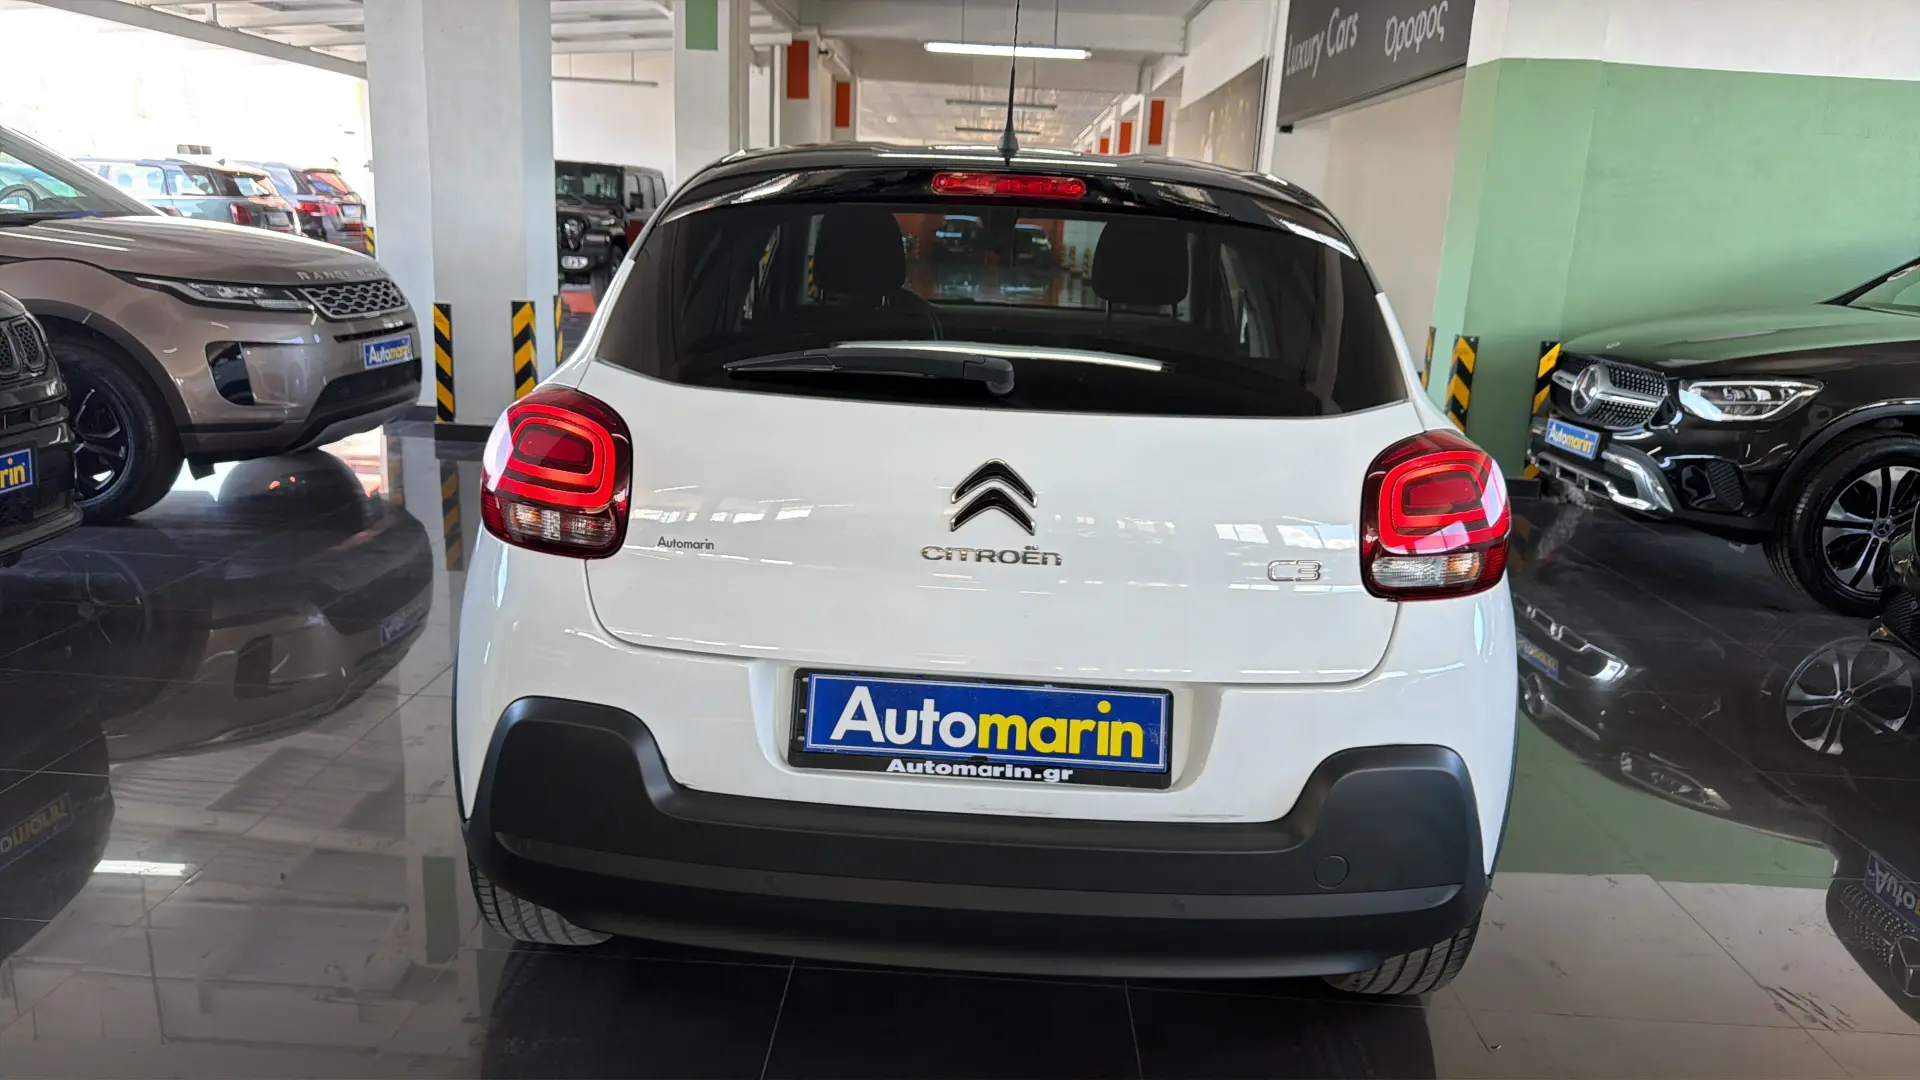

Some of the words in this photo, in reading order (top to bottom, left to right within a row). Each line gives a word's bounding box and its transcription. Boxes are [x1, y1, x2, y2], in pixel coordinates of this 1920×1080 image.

[1286, 30, 1325, 79] Luxury
[1326, 7, 1359, 58] Cars
[657, 536, 714, 550] Automarin
[1267, 560, 1322, 581] C3
[829, 685, 1143, 758] Automarin
[886, 758, 1073, 783] Automarin.gr
